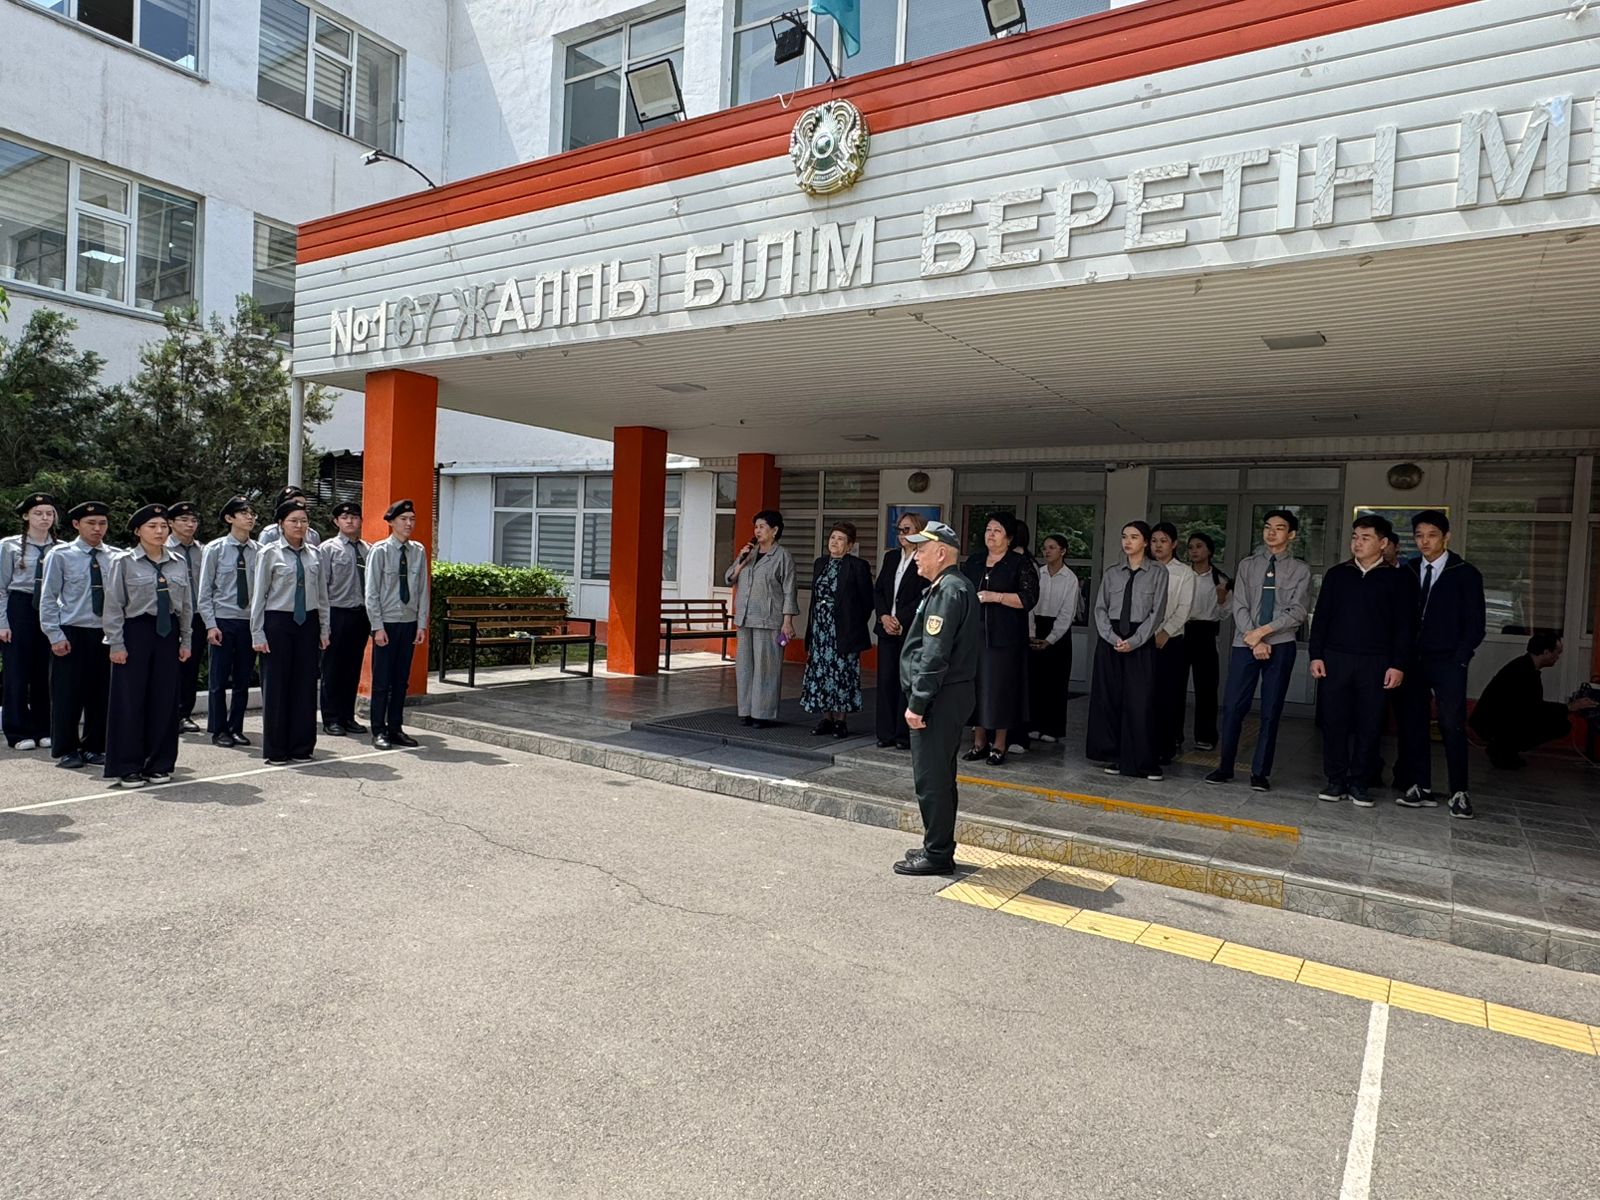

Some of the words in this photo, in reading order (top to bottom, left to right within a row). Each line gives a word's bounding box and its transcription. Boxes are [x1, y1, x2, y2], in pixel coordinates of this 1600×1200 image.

[330, 293, 441, 357] №167
[452, 253, 662, 341] ЖАЛПЫ
[683, 215, 877, 309] БІЛІМ
[920, 126, 1398, 279] БЕРЕТІН
